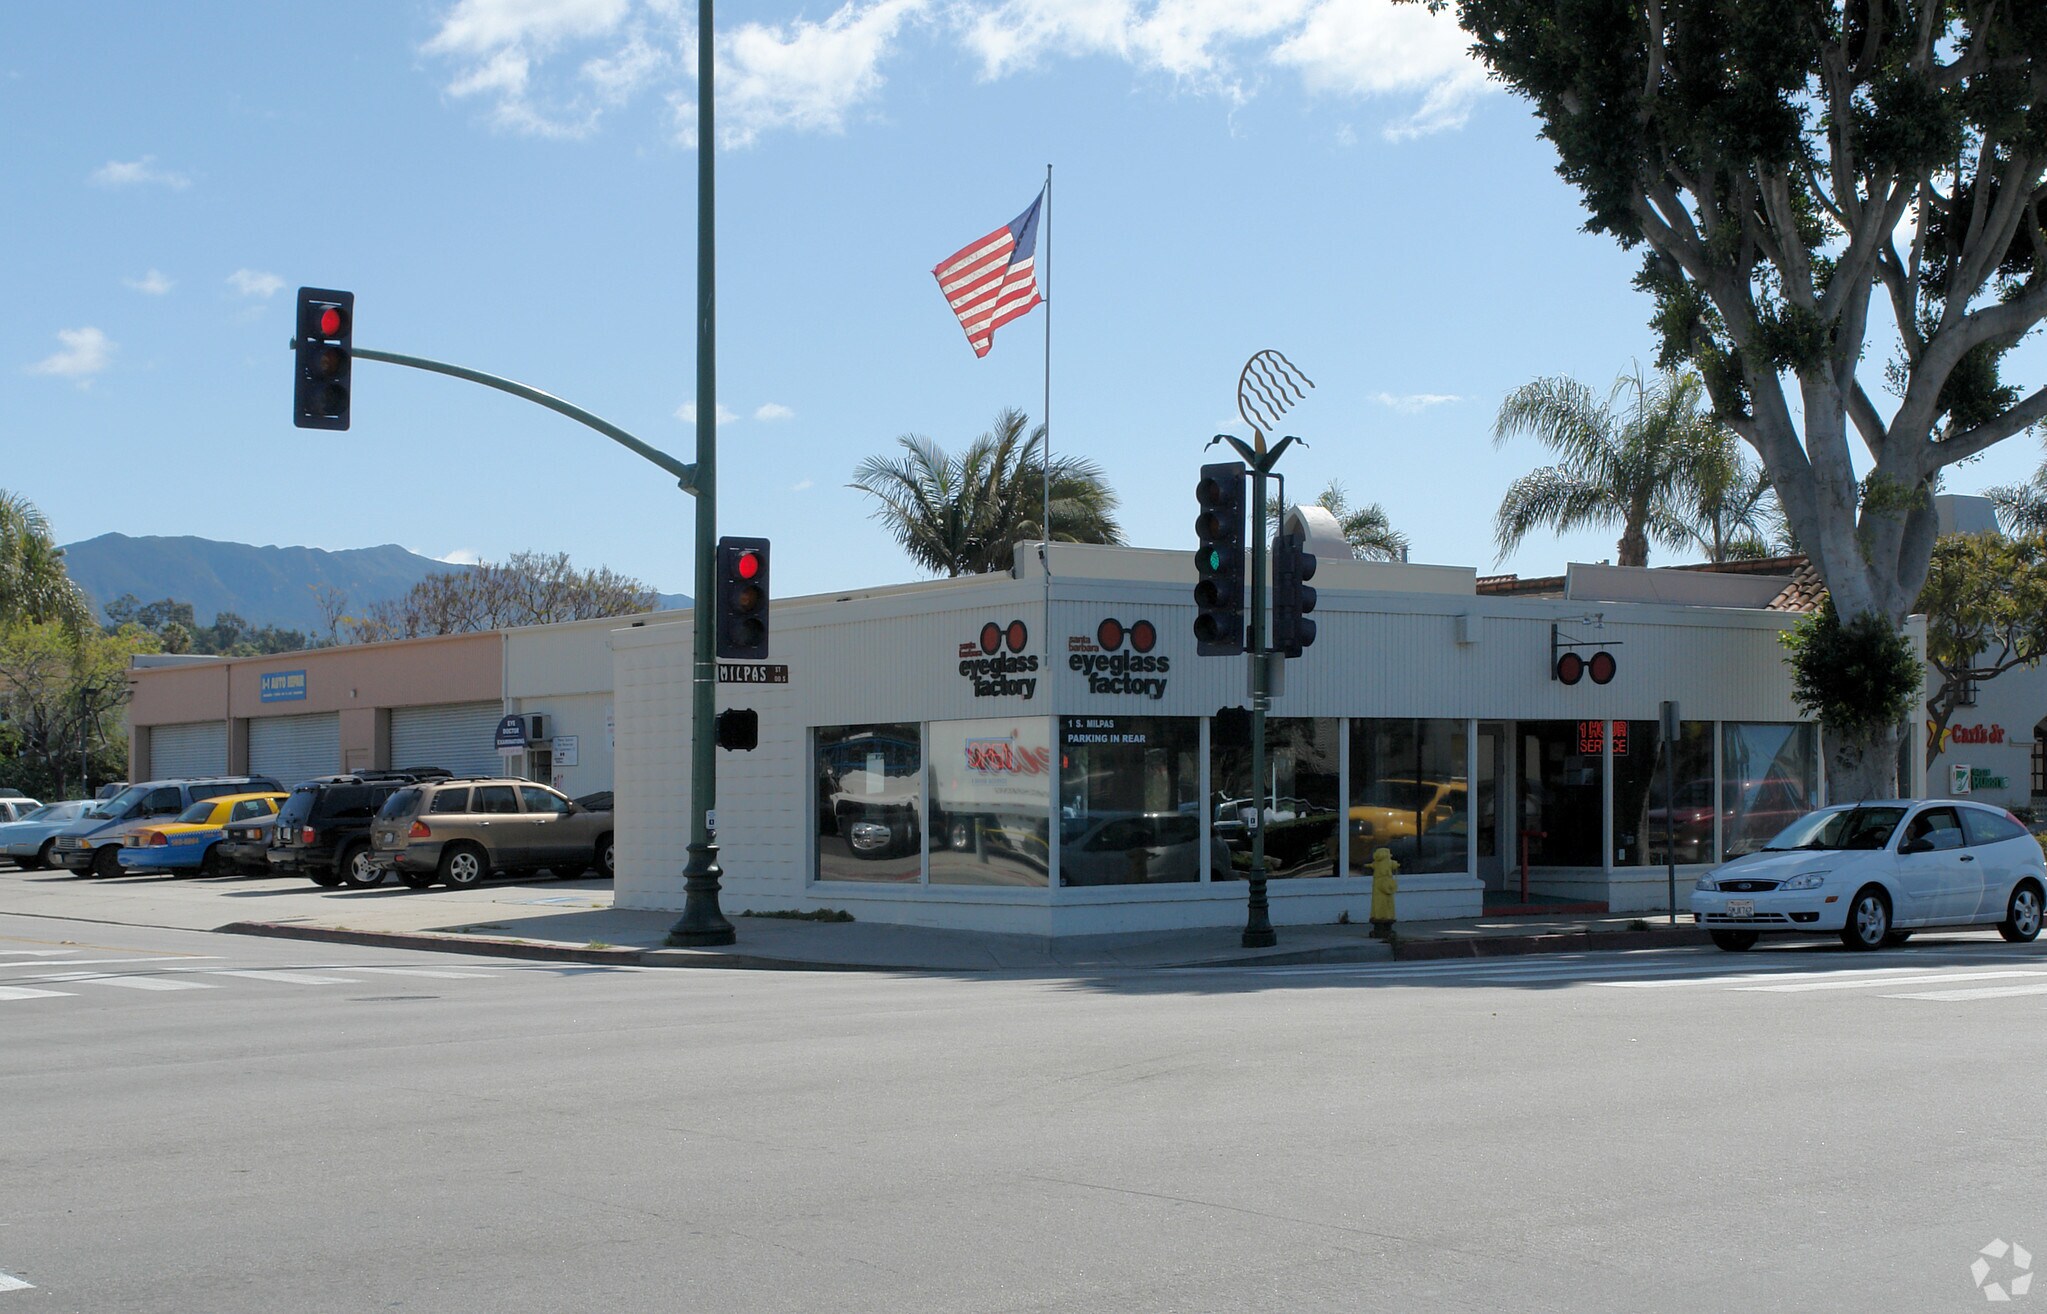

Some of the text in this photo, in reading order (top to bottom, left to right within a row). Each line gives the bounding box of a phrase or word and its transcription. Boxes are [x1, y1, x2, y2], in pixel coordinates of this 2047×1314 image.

[1068, 641, 1099, 652] barbara
[959, 651, 1038, 680] eyeglass
[1069, 650, 1170, 676] eyeglass
[720, 665, 766, 682] MILPAS
[973, 674, 1037, 700] factory
[1088, 672, 1168, 700] factory
[502, 727, 520, 735] DOCTOR
[1068, 719, 1115, 728] 1 S. MILPAS
[1067, 734, 1146, 743] PARKING IN REAR
